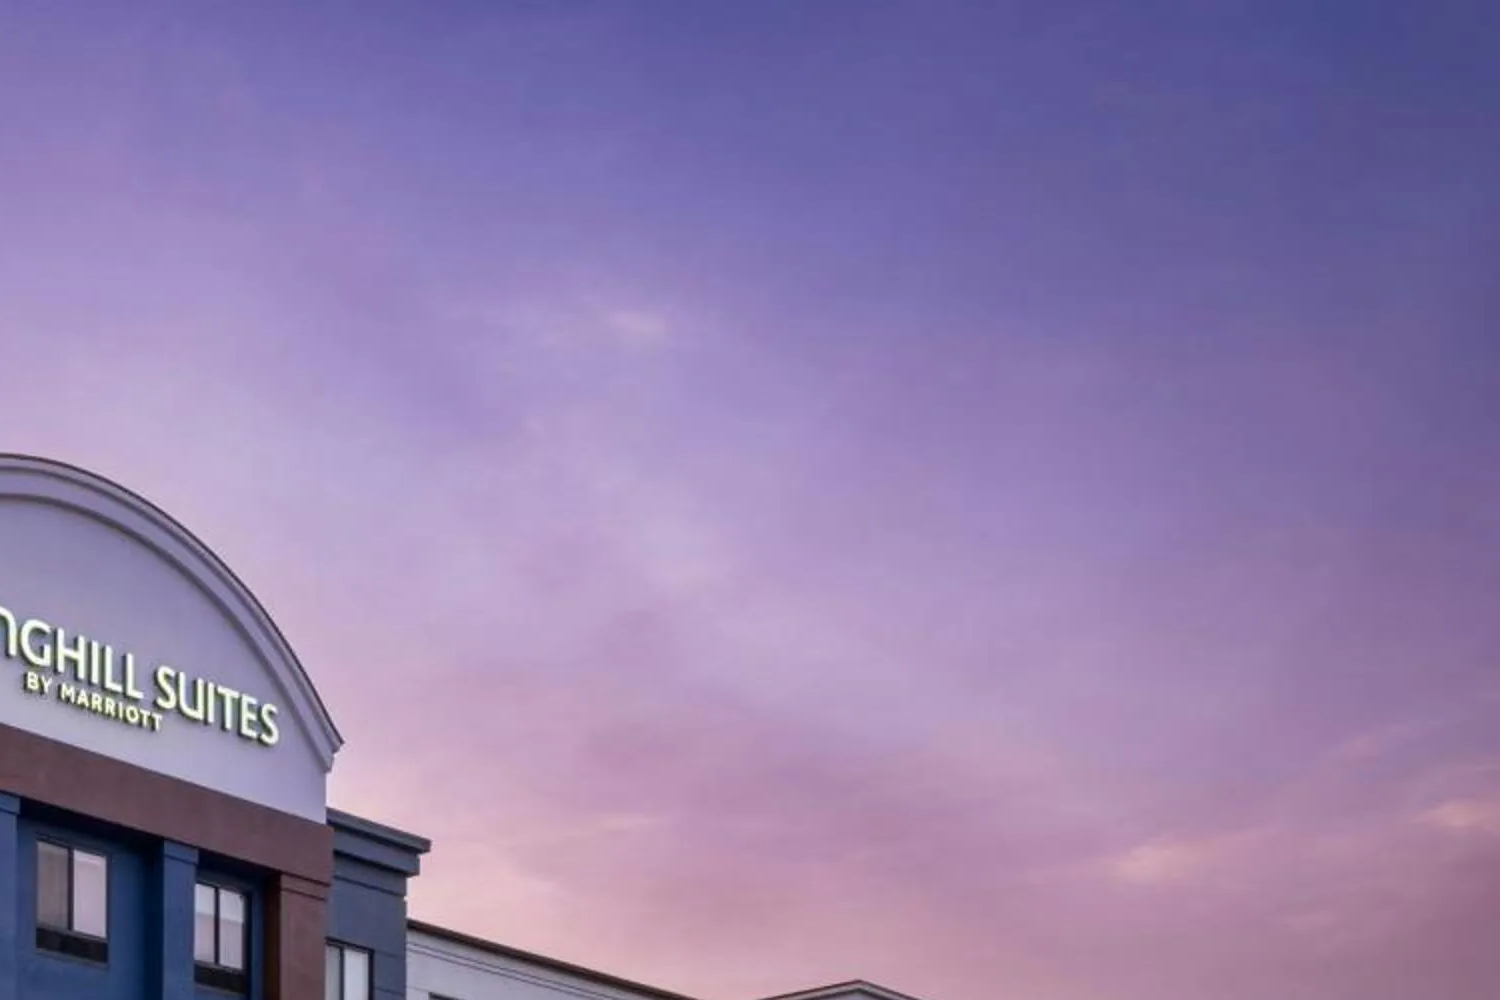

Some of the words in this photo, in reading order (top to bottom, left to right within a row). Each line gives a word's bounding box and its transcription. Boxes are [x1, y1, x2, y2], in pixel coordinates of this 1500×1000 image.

[25, 671, 53, 694] BY
[60, 683, 163, 731] MARRIOTT
[155, 665, 280, 746] SUITES
